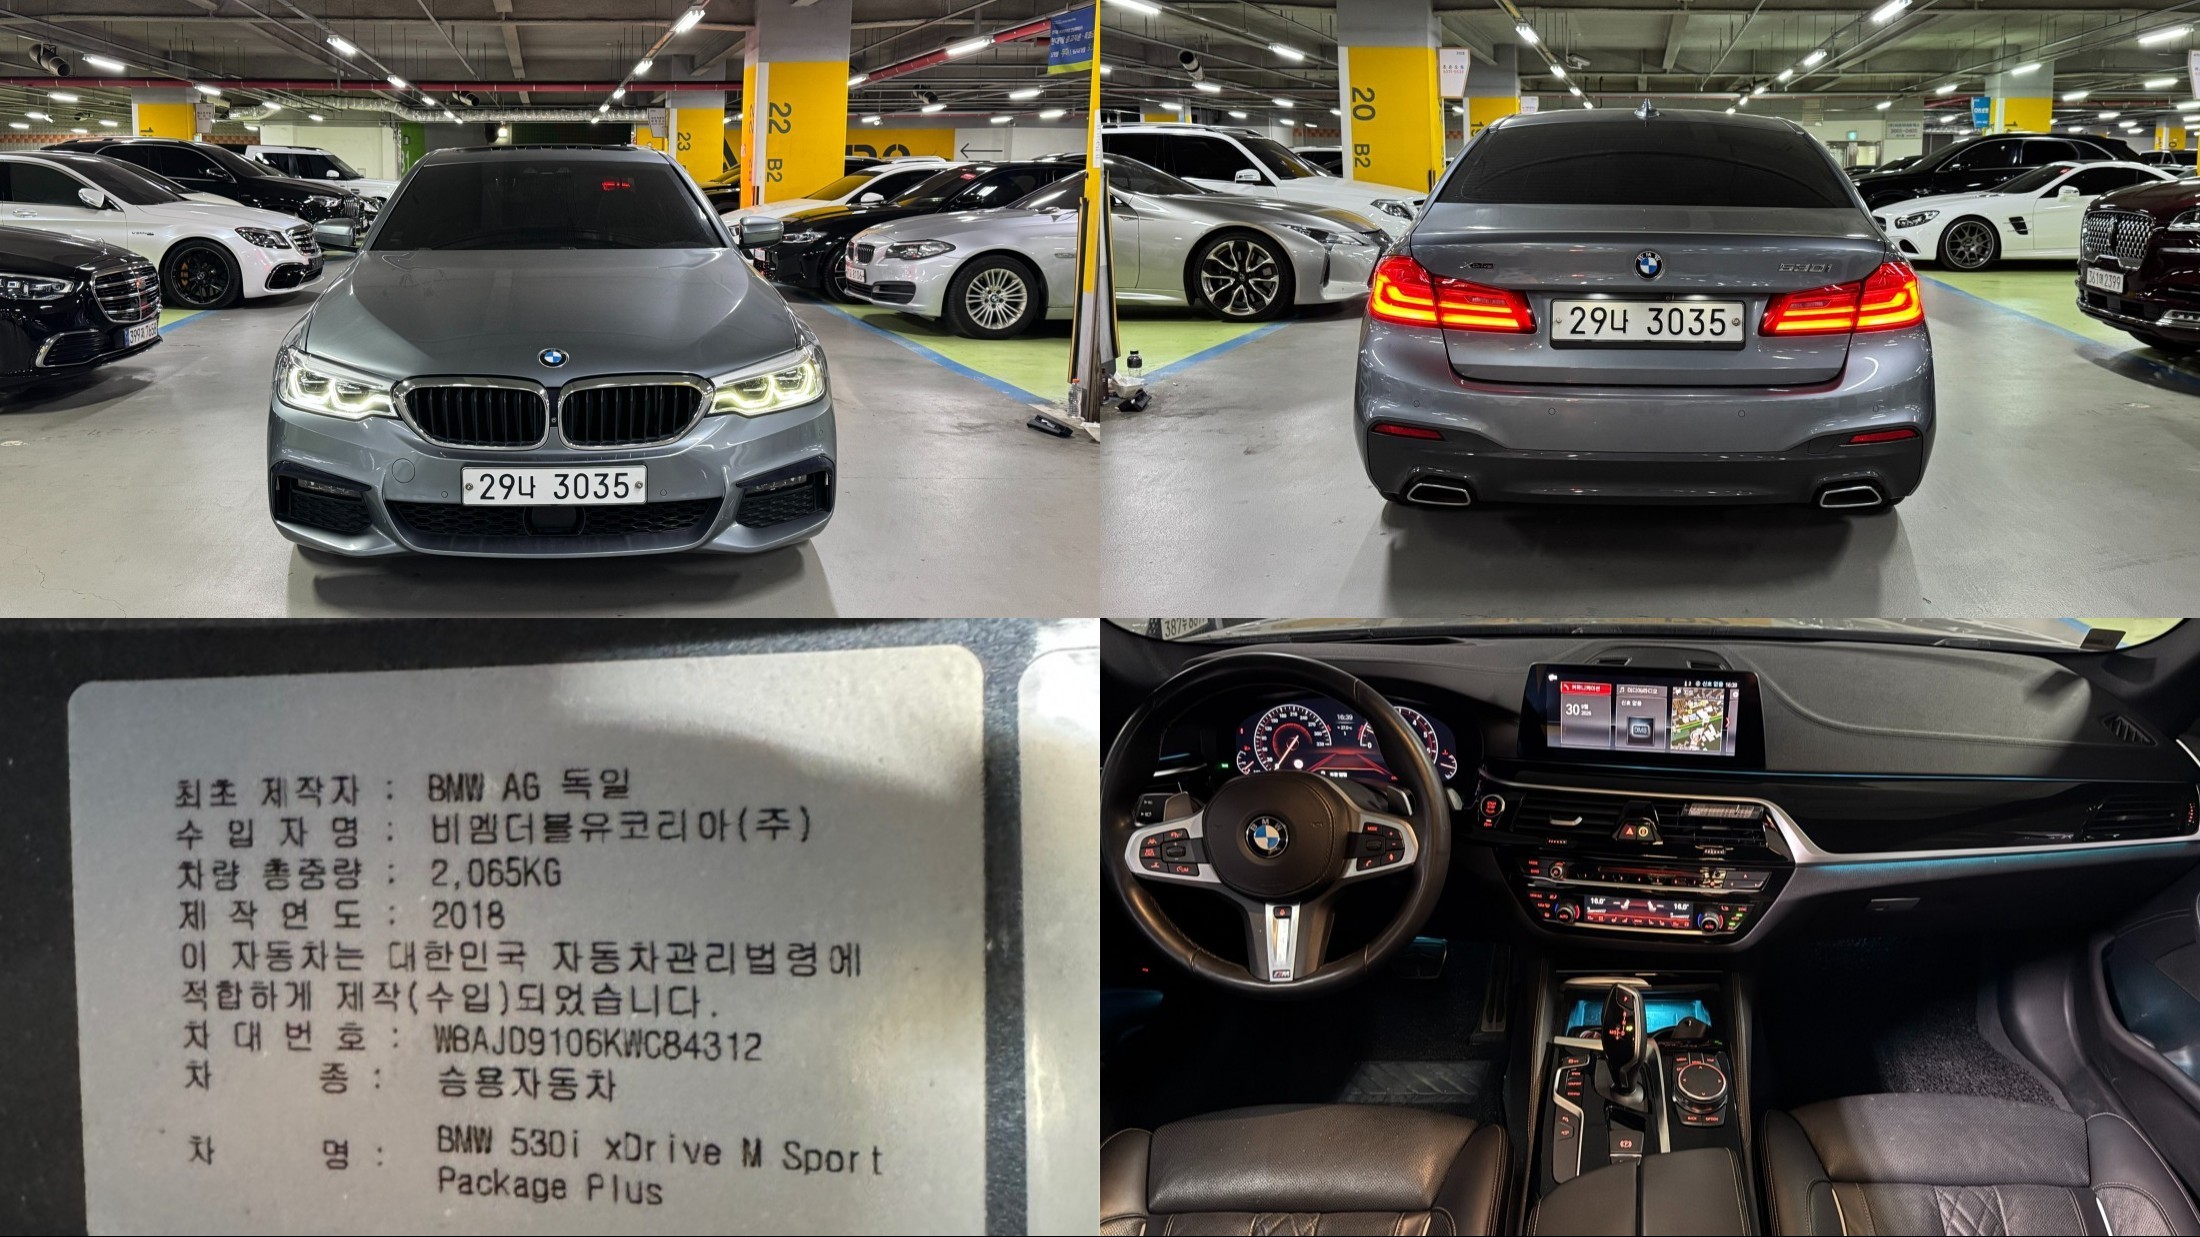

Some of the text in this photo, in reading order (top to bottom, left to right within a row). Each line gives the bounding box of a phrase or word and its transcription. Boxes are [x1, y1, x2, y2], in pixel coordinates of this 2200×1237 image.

[677, 132, 691, 152] 23
[767, 103, 792, 182] 22 B2
[1352, 87, 1376, 168] 20 B2
[1570, 307, 1726, 335] 29나 3035
[480, 473, 630, 500] 29나 3035
[1565, 703, 1580, 716] 30
[174, 778, 238, 810] 최초
[261, 773, 360, 809] 제작자
[427, 772, 485, 803] BMW
[501, 771, 541, 802] AG
[561, 767, 630, 800] 독일
[176, 858, 240, 892] 차량
[262, 856, 363, 892] 총중량
[430, 855, 562, 891] 2,065KG
[431, 899, 506, 931] 2018
[180, 939, 862, 979] 이 자동차는 대한민국 자동차관리법령에
[181, 979, 718, 1020] 적합하게 제작(수입)되었습니다.
[432, 1023, 763, 1062] WBAJD9106KWC84312
[184, 1059, 213, 1092] 차
[319, 1062, 349, 1095] 종
[438, 1064, 617, 1103] 승용자동차
[188, 1134, 216, 1166] 차
[322, 1139, 349, 1171] 명
[436, 1123, 493, 1155] BMW
[510, 1126, 579, 1159] 530i
[604, 1130, 722, 1167] xDrive
[741, 1136, 763, 1169] M
[781, 1139, 883, 1176] Sport
[437, 1165, 664, 1206] Package Plus
